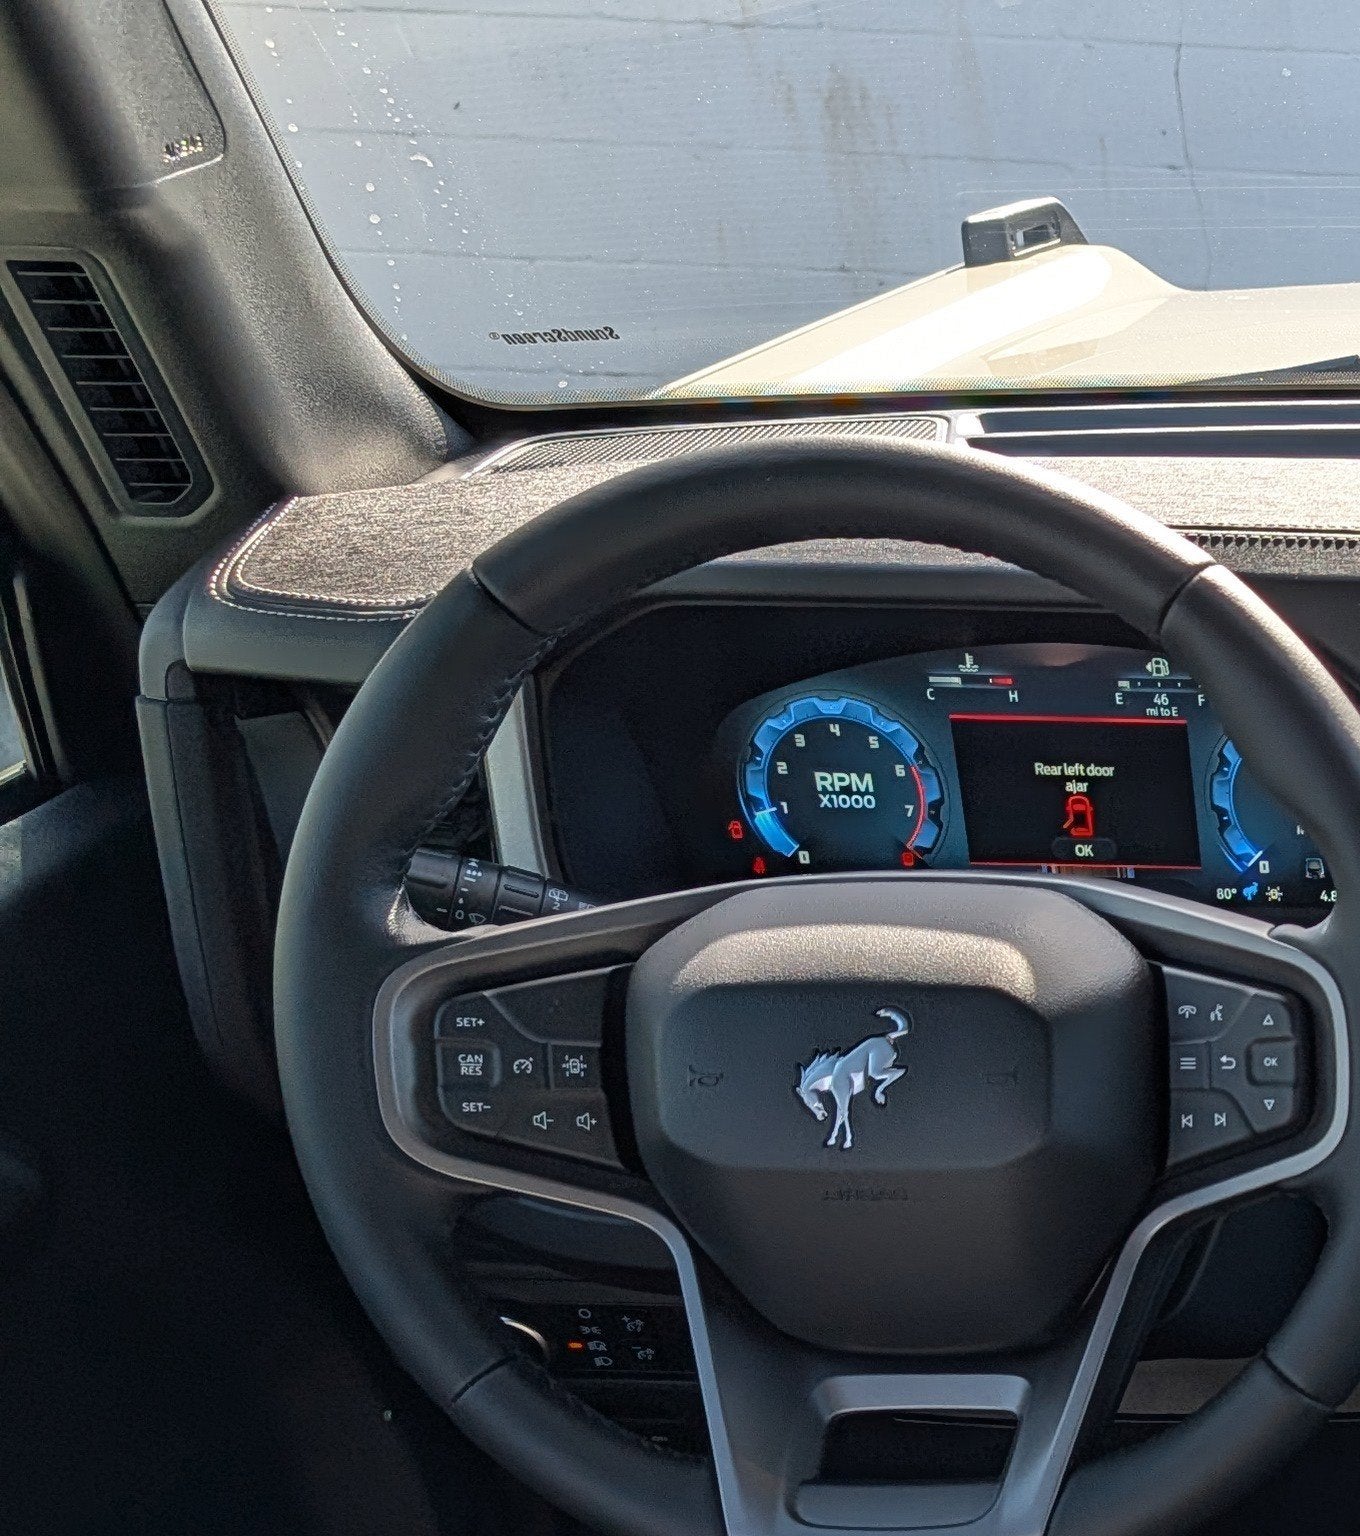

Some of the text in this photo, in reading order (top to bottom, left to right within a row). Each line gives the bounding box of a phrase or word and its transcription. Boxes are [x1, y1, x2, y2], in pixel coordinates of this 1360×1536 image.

[926, 687, 936, 701] C
[1008, 690, 1019, 703] H
[1115, 692, 1124, 705] E
[1153, 693, 1170, 706] 46
[1197, 694, 1206, 707] F
[1146, 707, 1179, 717] mi to E
[829, 723, 841, 737] 4
[794, 733, 806, 748] 3
[868, 735, 880, 749] 5
[776, 761, 789, 775] 2
[895, 764, 906, 777] 6
[1034, 762, 1116, 777] Rear left door
[814, 771, 875, 793] RPM
[1065, 779, 1089, 794] ajar
[780, 801, 789, 814] 1
[904, 804, 915, 818] 7
[798, 850, 811, 864] 0
[1074, 843, 1094, 857] OK
[1258, 860, 1270, 874] 0
[458, 1054, 483, 1063] CAN
[1263, 1057, 1278, 1067] OK
[460, 1066, 483, 1076] RES
